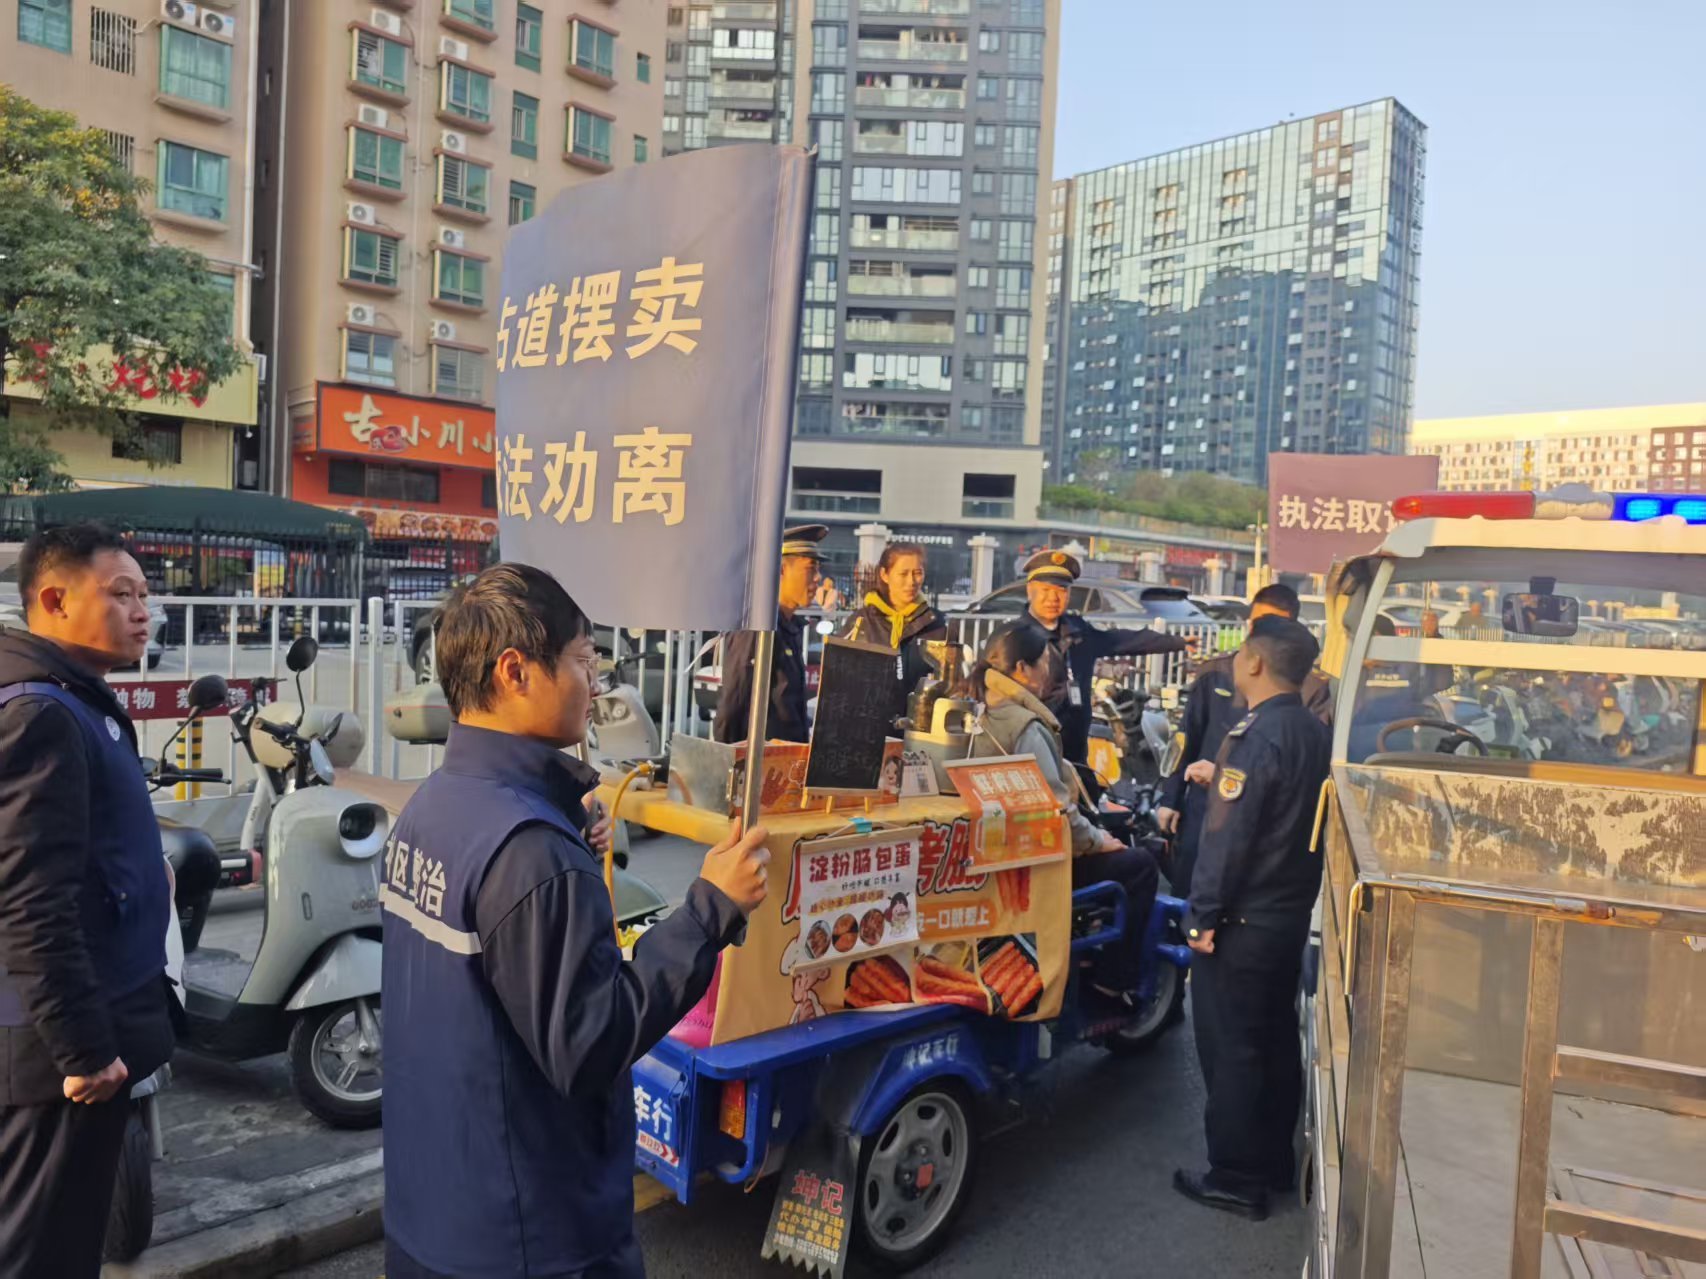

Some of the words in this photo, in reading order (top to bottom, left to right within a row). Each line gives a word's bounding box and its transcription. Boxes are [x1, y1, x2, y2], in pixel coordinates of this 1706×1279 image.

[496, 427, 693, 527] 法劝离
[917, 535, 954, 545] COFFEE
[809, 842, 911, 882] 淀粉肠包蛋
[791, 1169, 844, 1215] 坤记
